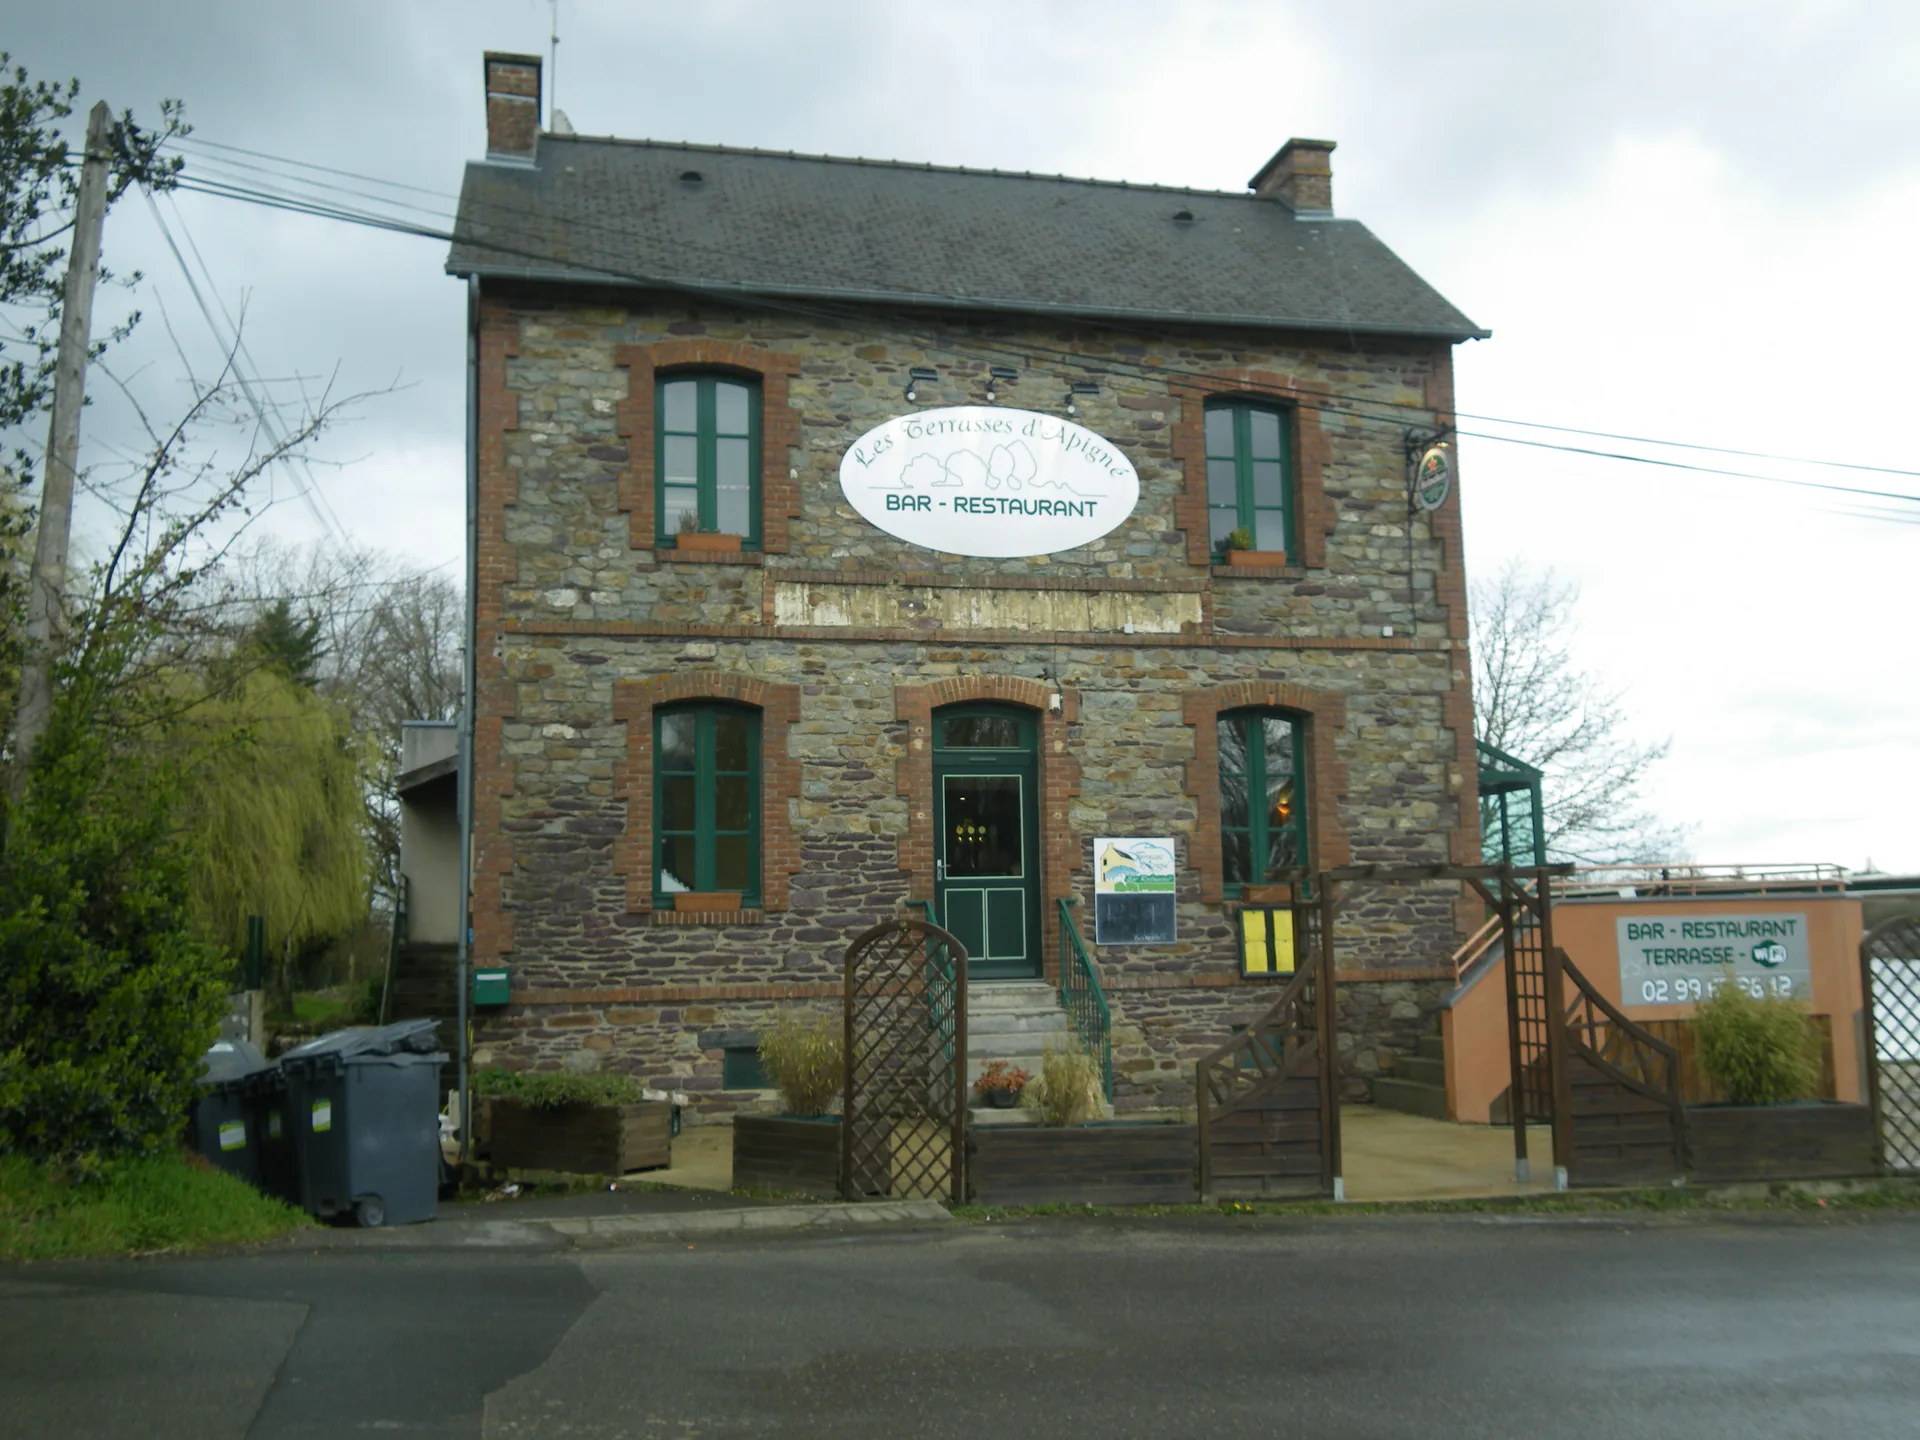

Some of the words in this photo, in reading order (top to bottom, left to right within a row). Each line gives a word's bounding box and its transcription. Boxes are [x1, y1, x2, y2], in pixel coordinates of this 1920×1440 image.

[854, 434, 894, 468] Les
[902, 418, 1013, 439] Terrasses
[886, 494, 932, 512] BAR
[953, 496, 1098, 518] RESTAURANT
[1627, 922, 1665, 940] BAR
[1682, 919, 1798, 939] RESTAURANT
[1642, 947, 1735, 966] TERRASSE
[1642, 979, 1669, 1002] 02
[1675, 978, 1702, 1001] 99
[1771, 975, 1793, 998] 12
